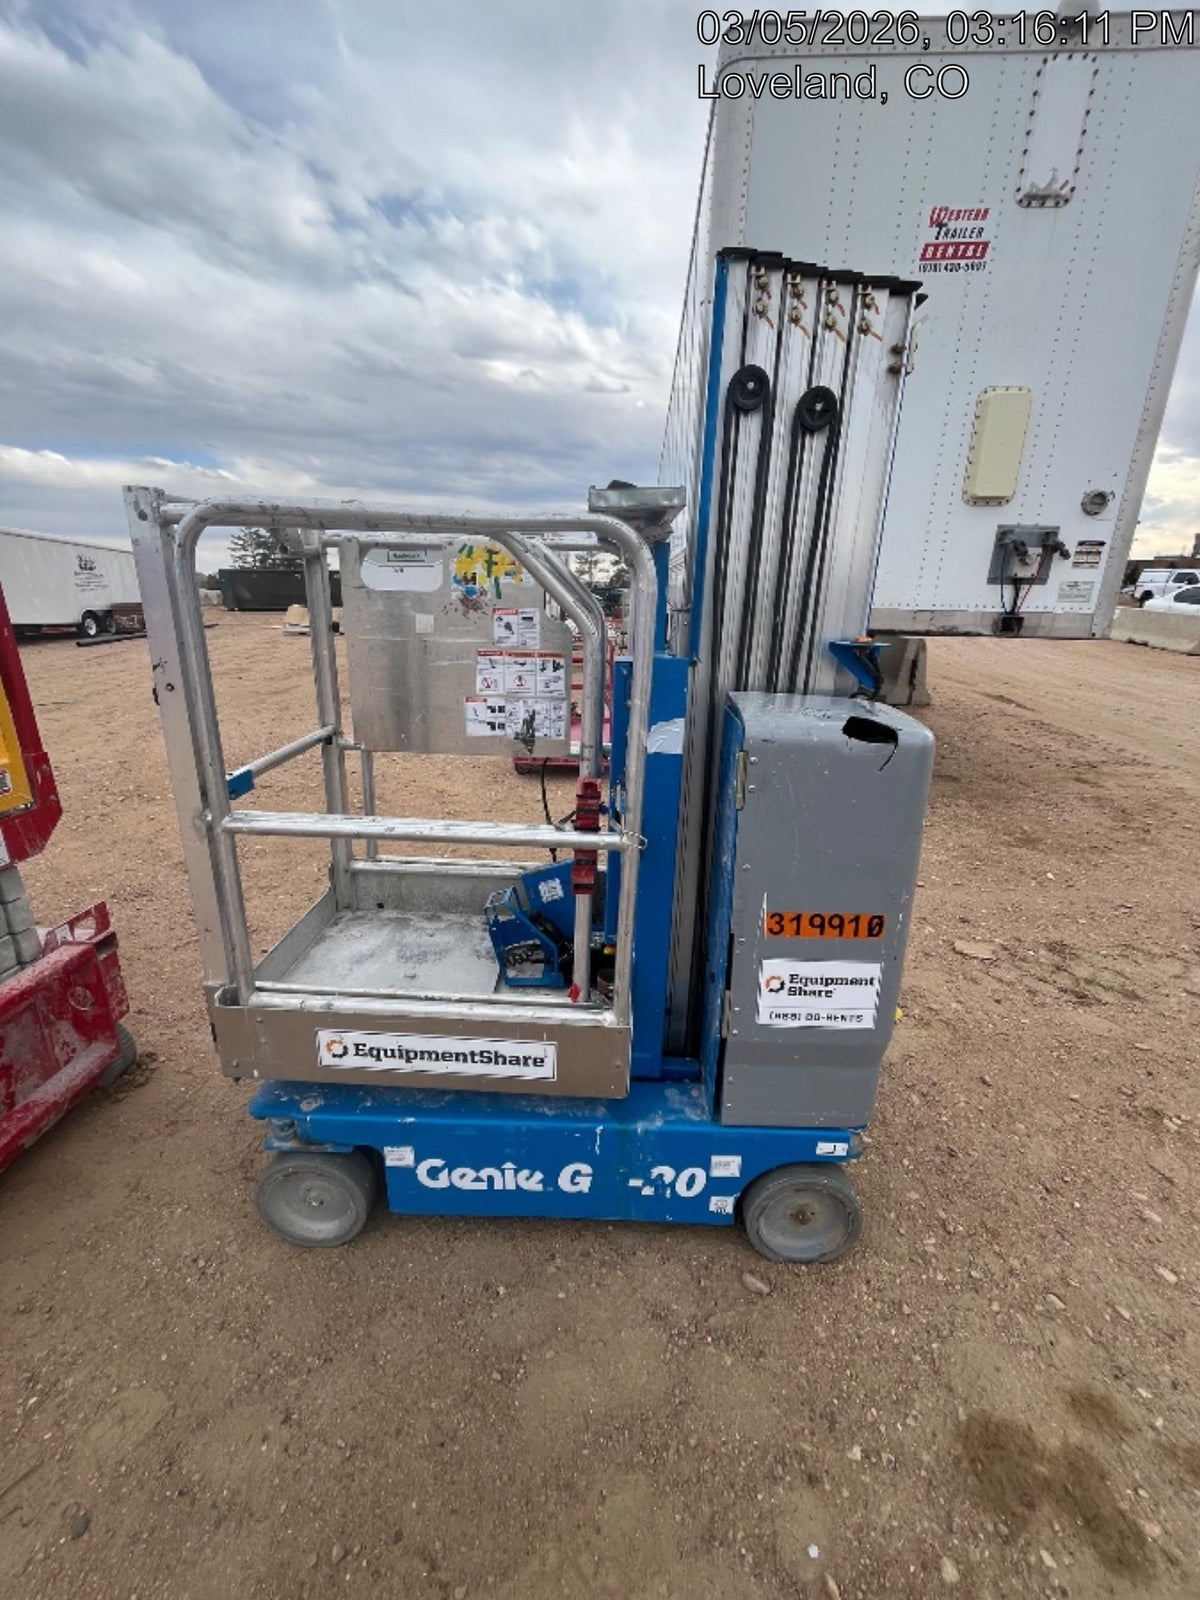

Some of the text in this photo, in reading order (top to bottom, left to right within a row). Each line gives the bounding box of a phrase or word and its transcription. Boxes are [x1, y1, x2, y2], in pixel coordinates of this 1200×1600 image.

[767, 912, 885, 937] 319910
[787, 986, 834, 999] Share
[788, 973, 875, 988] Equipment
[353, 1042, 545, 1068] EquipmentShare
[416, 1158, 545, 1192] Genie
